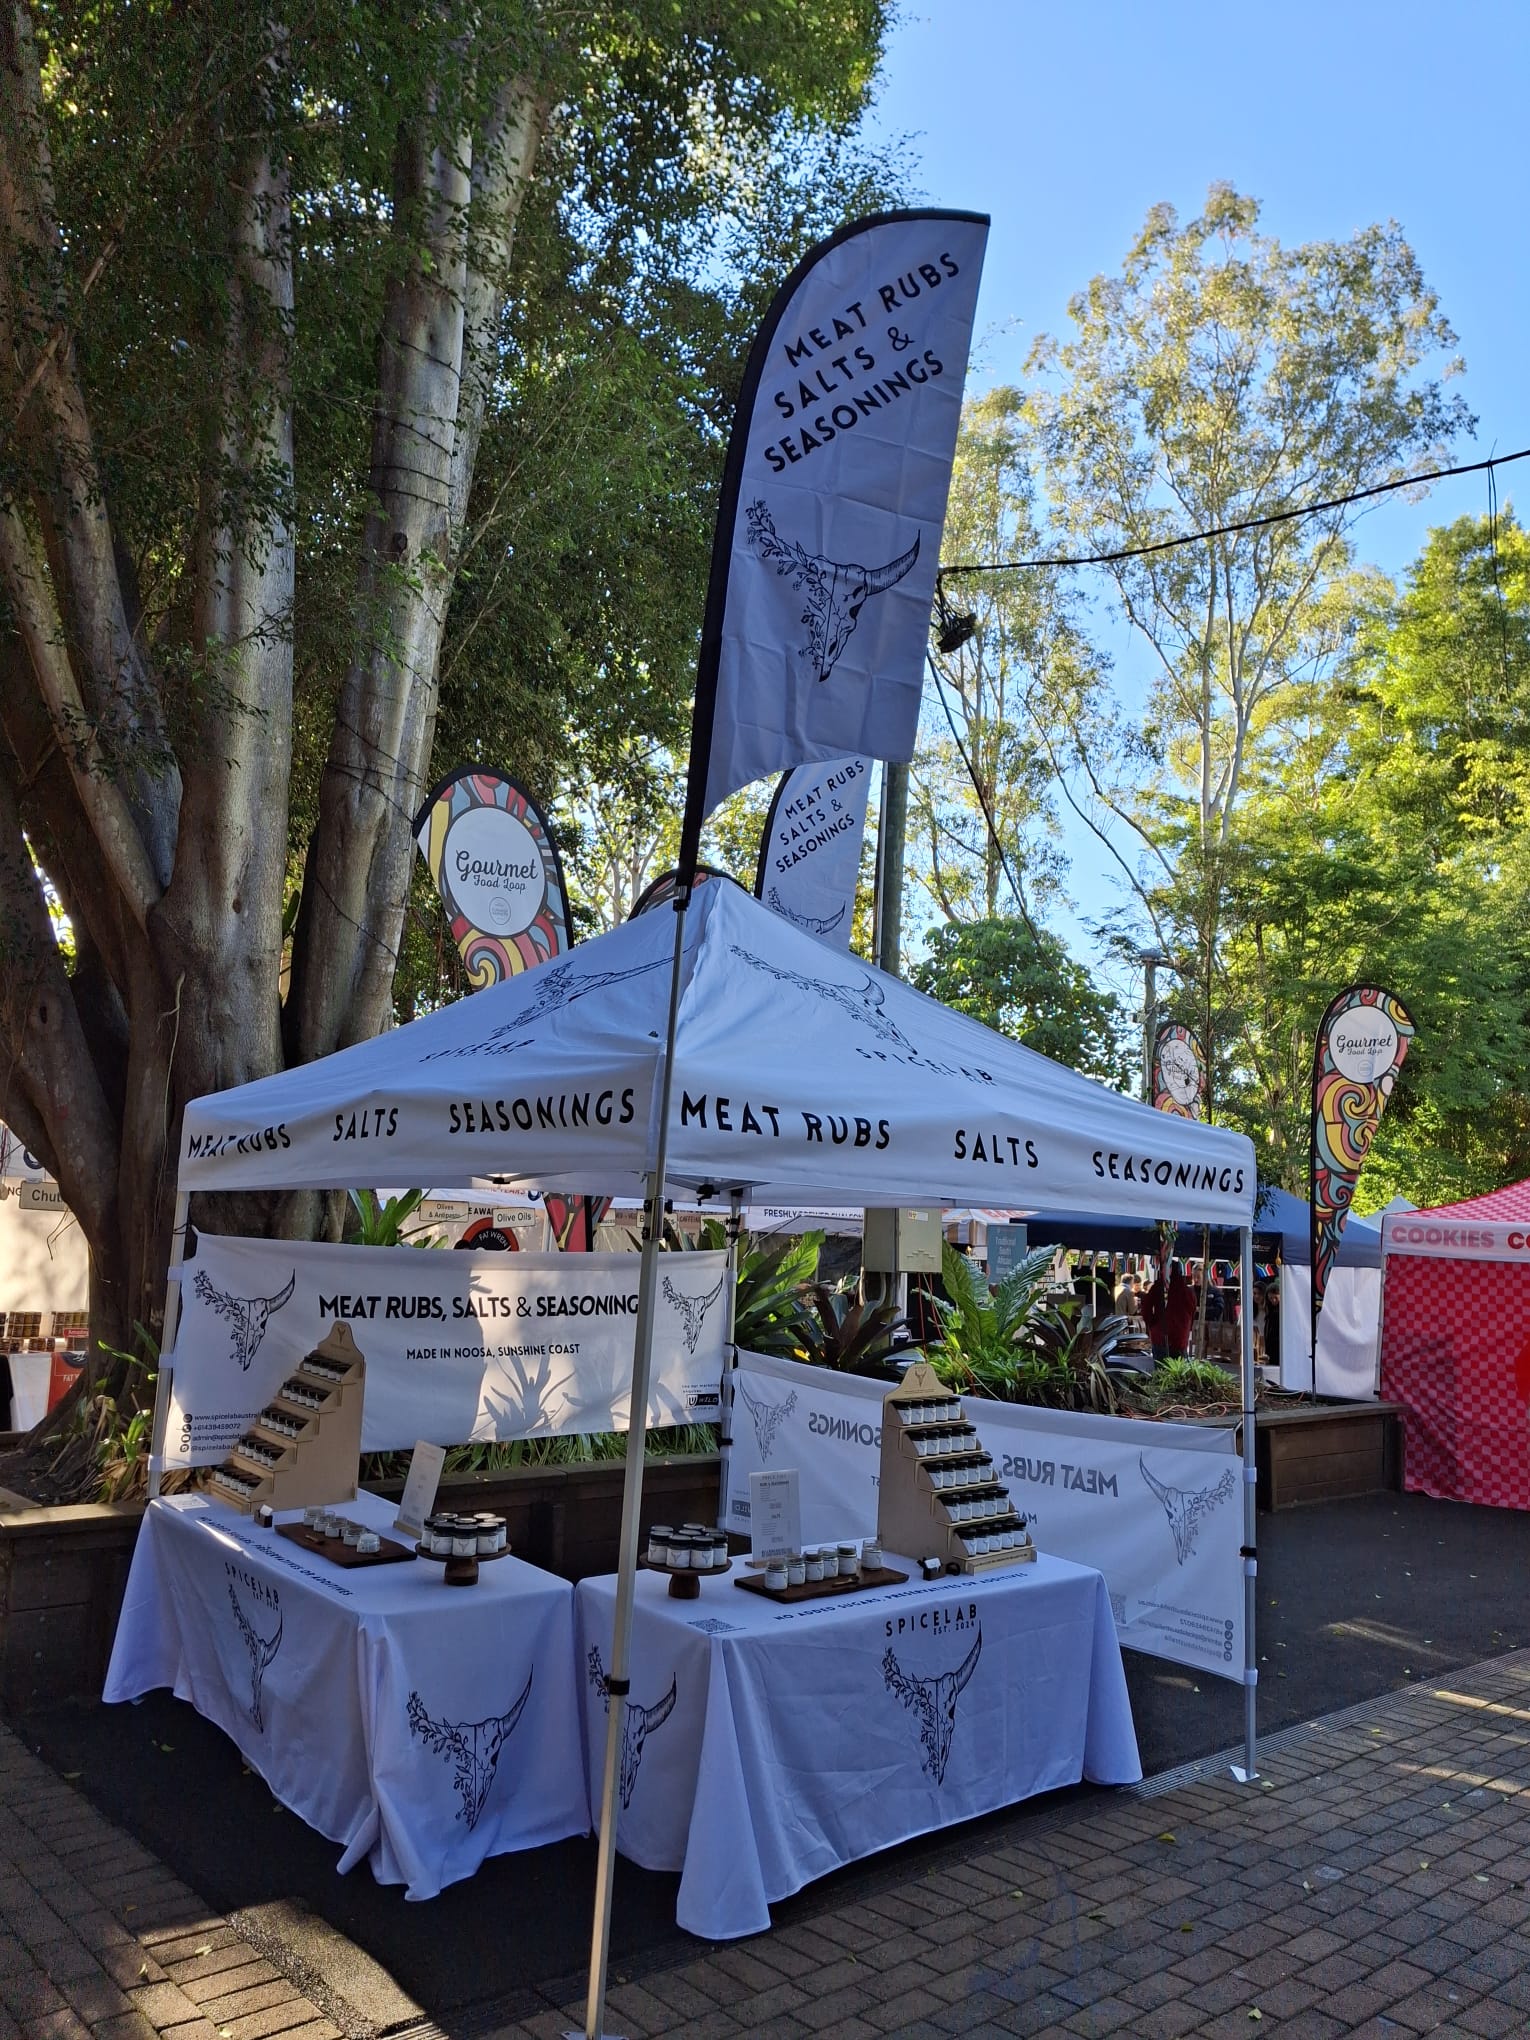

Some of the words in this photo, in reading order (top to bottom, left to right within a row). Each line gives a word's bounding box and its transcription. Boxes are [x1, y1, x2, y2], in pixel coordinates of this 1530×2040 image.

[784, 302, 867, 368] MEAT
[878, 252, 960, 313] RUBS
[774, 346, 875, 419] SALTS
[888, 326, 915, 351] &
[764, 350, 943, 473] SEASONINGS
[784, 786, 822, 819] MEAT
[827, 760, 864, 791] RUBS
[780, 809, 826, 845] SALTS
[831, 799, 843, 811] &
[776, 813, 855, 873] SEASONINGS
[456, 849, 538, 881] Gourmet
[474, 874, 500, 888] Food
[503, 878, 526, 895] Loop
[1336, 1034, 1393, 1053] Gourmet
[855, 1048, 993, 1081] SPICELAB
[333, 1108, 399, 1142] SALTS
[449, 1088, 635, 1134] SEASONINGS
[681, 1090, 782, 1137] MEAT
[800, 1111, 891, 1149] RUBS
[188, 1134, 238, 1158] MEAT
[954, 1129, 1039, 1168] SALTS
[1092, 1151, 1244, 1193] SEASONINGS
[497, 1213, 516, 1222] Olive
[517, 1212, 532, 1221] Oils
[764, 1209, 797, 1218] FRESHLY
[478, 1232, 489, 1241] FAT
[490, 1232, 508, 1247] WREN
[1391, 1225, 1495, 1249] COOKIES
[319, 1295, 382, 1318] MEAT
[385, 1296, 447, 1322] RUBS,
[452, 1296, 511, 1318] SALTS
[516, 1296, 532, 1317] &
[536, 1294, 639, 1317] SEASONING
[406, 1348, 437, 1360] MADE
[440, 1348, 451, 1359] IN
[454, 1347, 496, 1360] NOOSA,
[498, 1345, 546, 1357] SUNSHINE
[549, 1344, 580, 1355] COAST
[225, 1562, 280, 1605] SPICELAB
[797, 1605, 836, 1616] ADDED
[884, 1583, 962, 1600] PRESERVATIVES
[963, 1579, 978, 1587] OR
[979, 1572, 1029, 1586] ADDITIVES
[885, 1603, 977, 1637] SPICELAB
[933, 1626, 951, 1636] EST.
[955, 1620, 976, 1631] 2024
